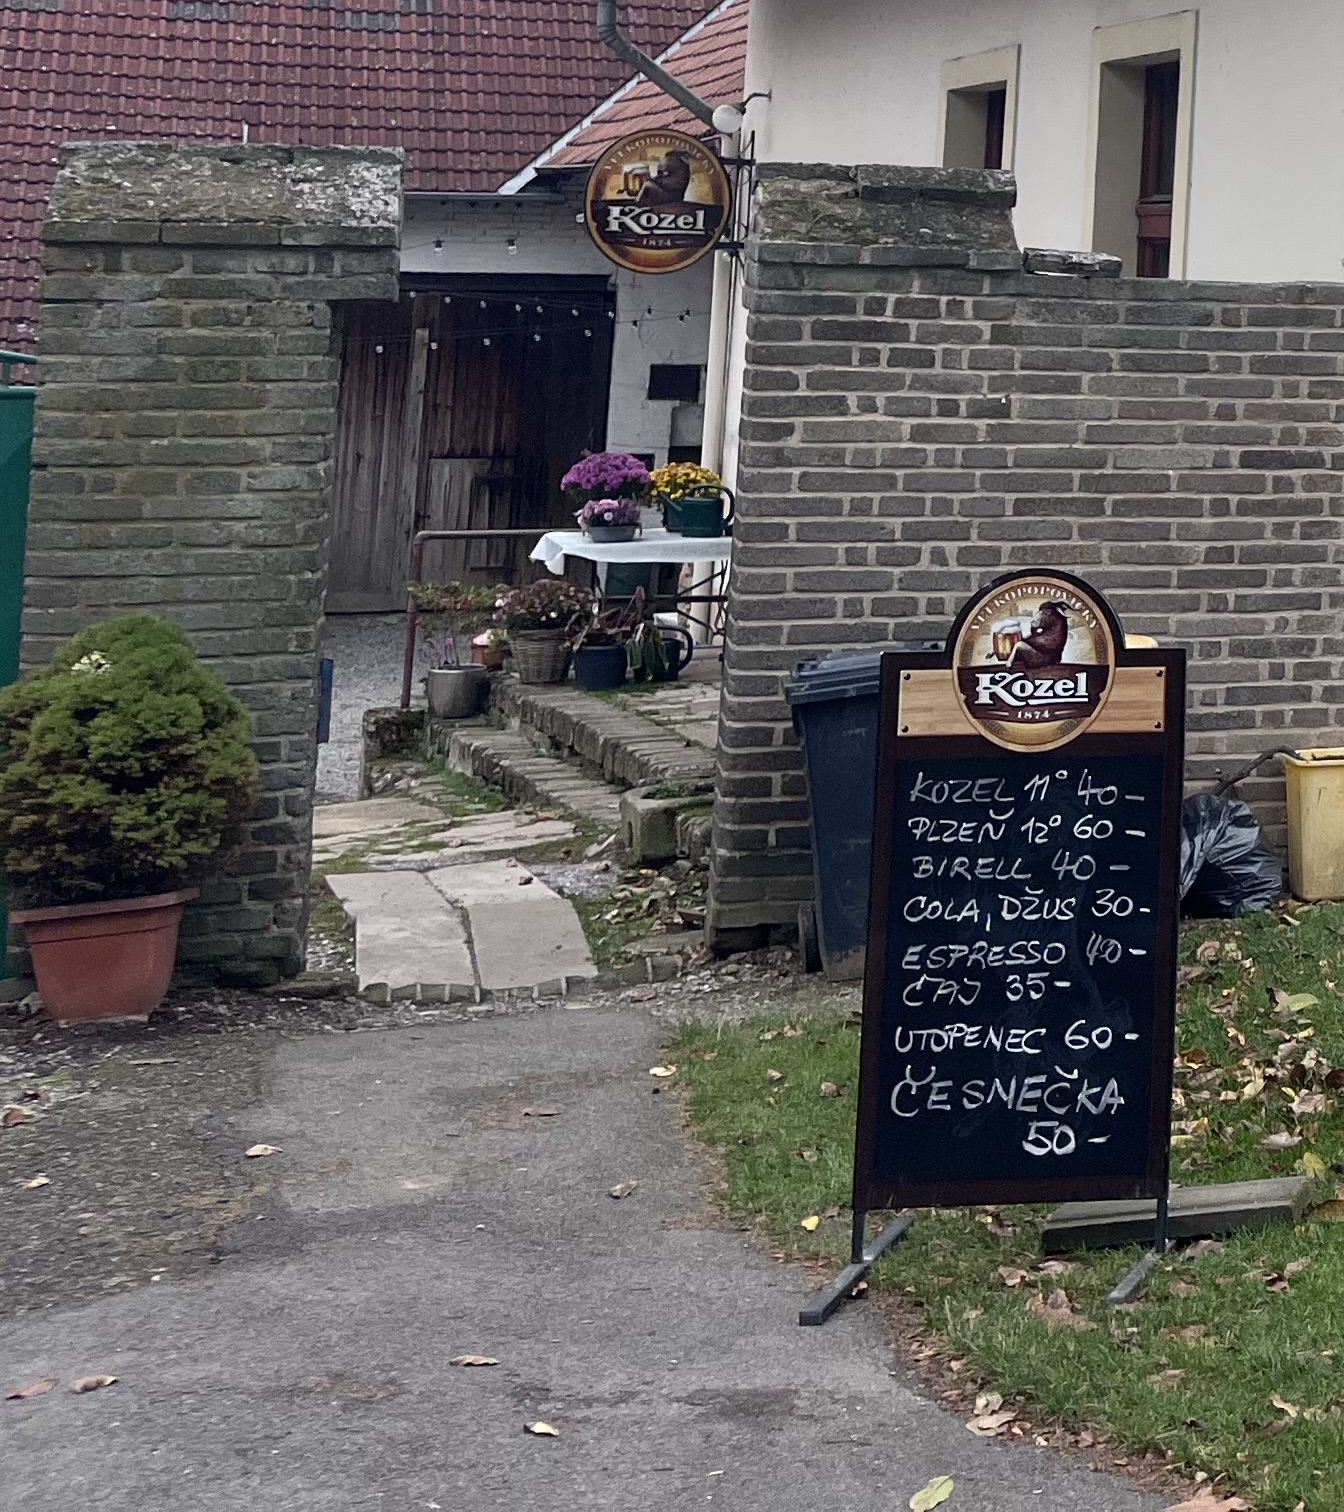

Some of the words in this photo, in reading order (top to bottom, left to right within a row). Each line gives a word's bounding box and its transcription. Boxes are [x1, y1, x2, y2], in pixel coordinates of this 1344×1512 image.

[605, 206, 705, 235] Kozel
[974, 672, 1089, 707] Kozel
[1016, 709, 1051, 720] 1874
[910, 772, 1015, 803] KOZEL
[908, 808, 1014, 844] PLZEŇ
[912, 855, 1031, 881] BIRELL
[998, 886, 1076, 921] DŽUS
[901, 941, 1066, 970] ESPRESSO
[894, 1023, 1047, 1054] UTOPENEC
[890, 1064, 1125, 1117] ČESNEČKA
